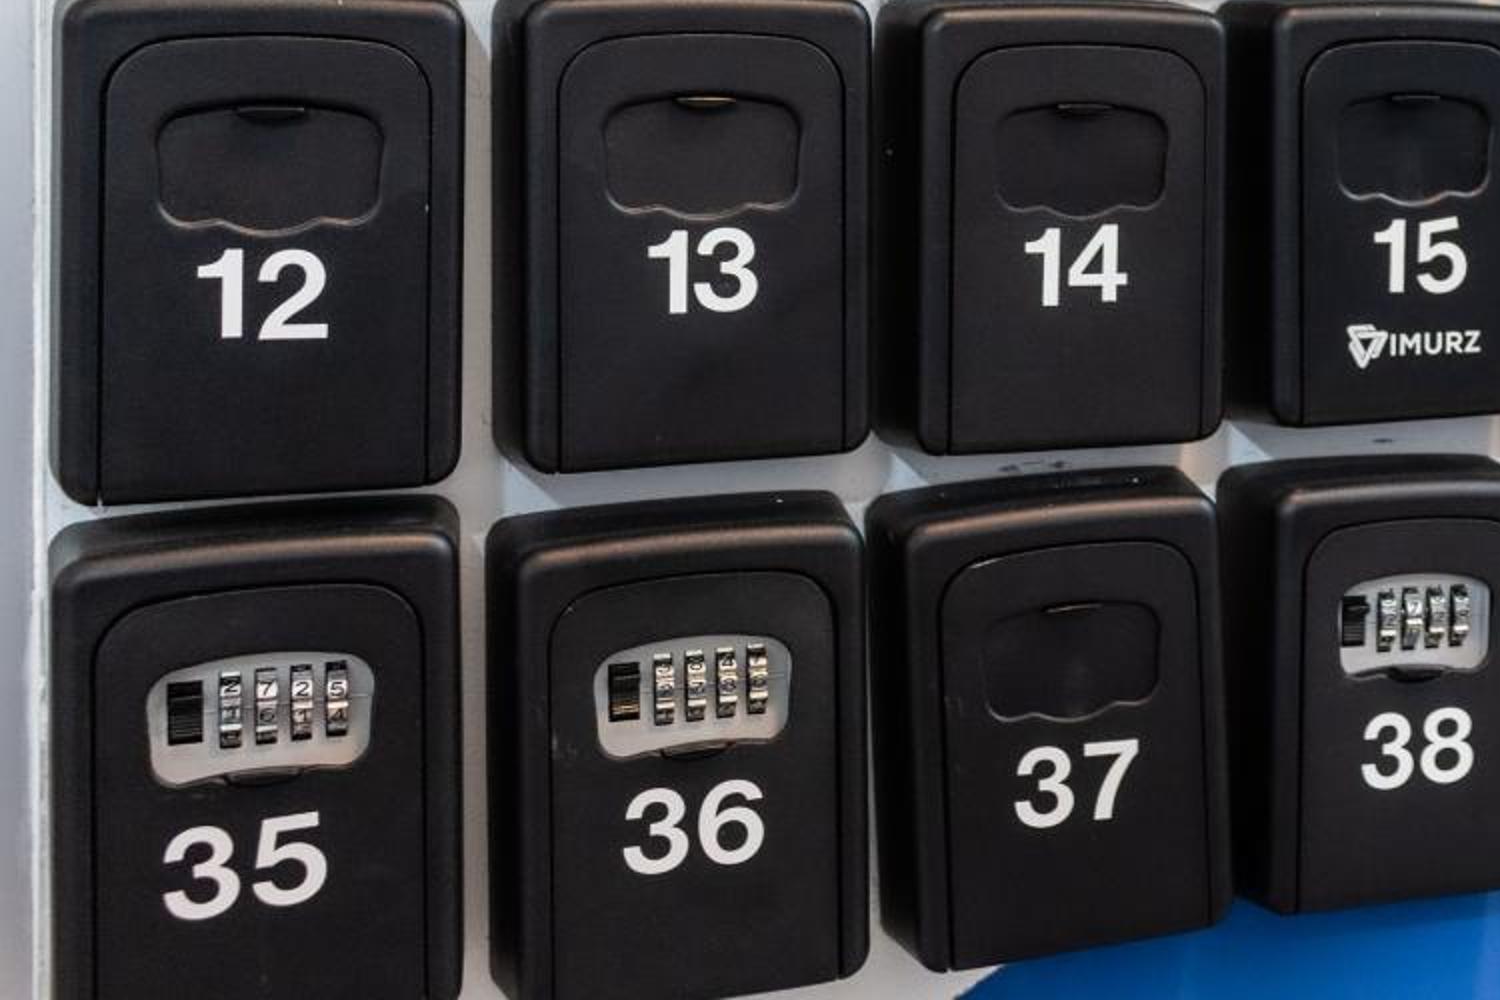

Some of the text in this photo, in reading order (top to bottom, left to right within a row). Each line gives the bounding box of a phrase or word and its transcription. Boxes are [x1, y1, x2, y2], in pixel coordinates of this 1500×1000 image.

[197, 248, 328, 340] 12
[648, 227, 758, 314] 13
[1025, 224, 1128, 306] 14
[1374, 216, 1467, 294] 15
[1015, 739, 1138, 828] 37
[1361, 707, 1474, 790] 38
[164, 811, 327, 920] 35
[623, 780, 764, 874] 36
